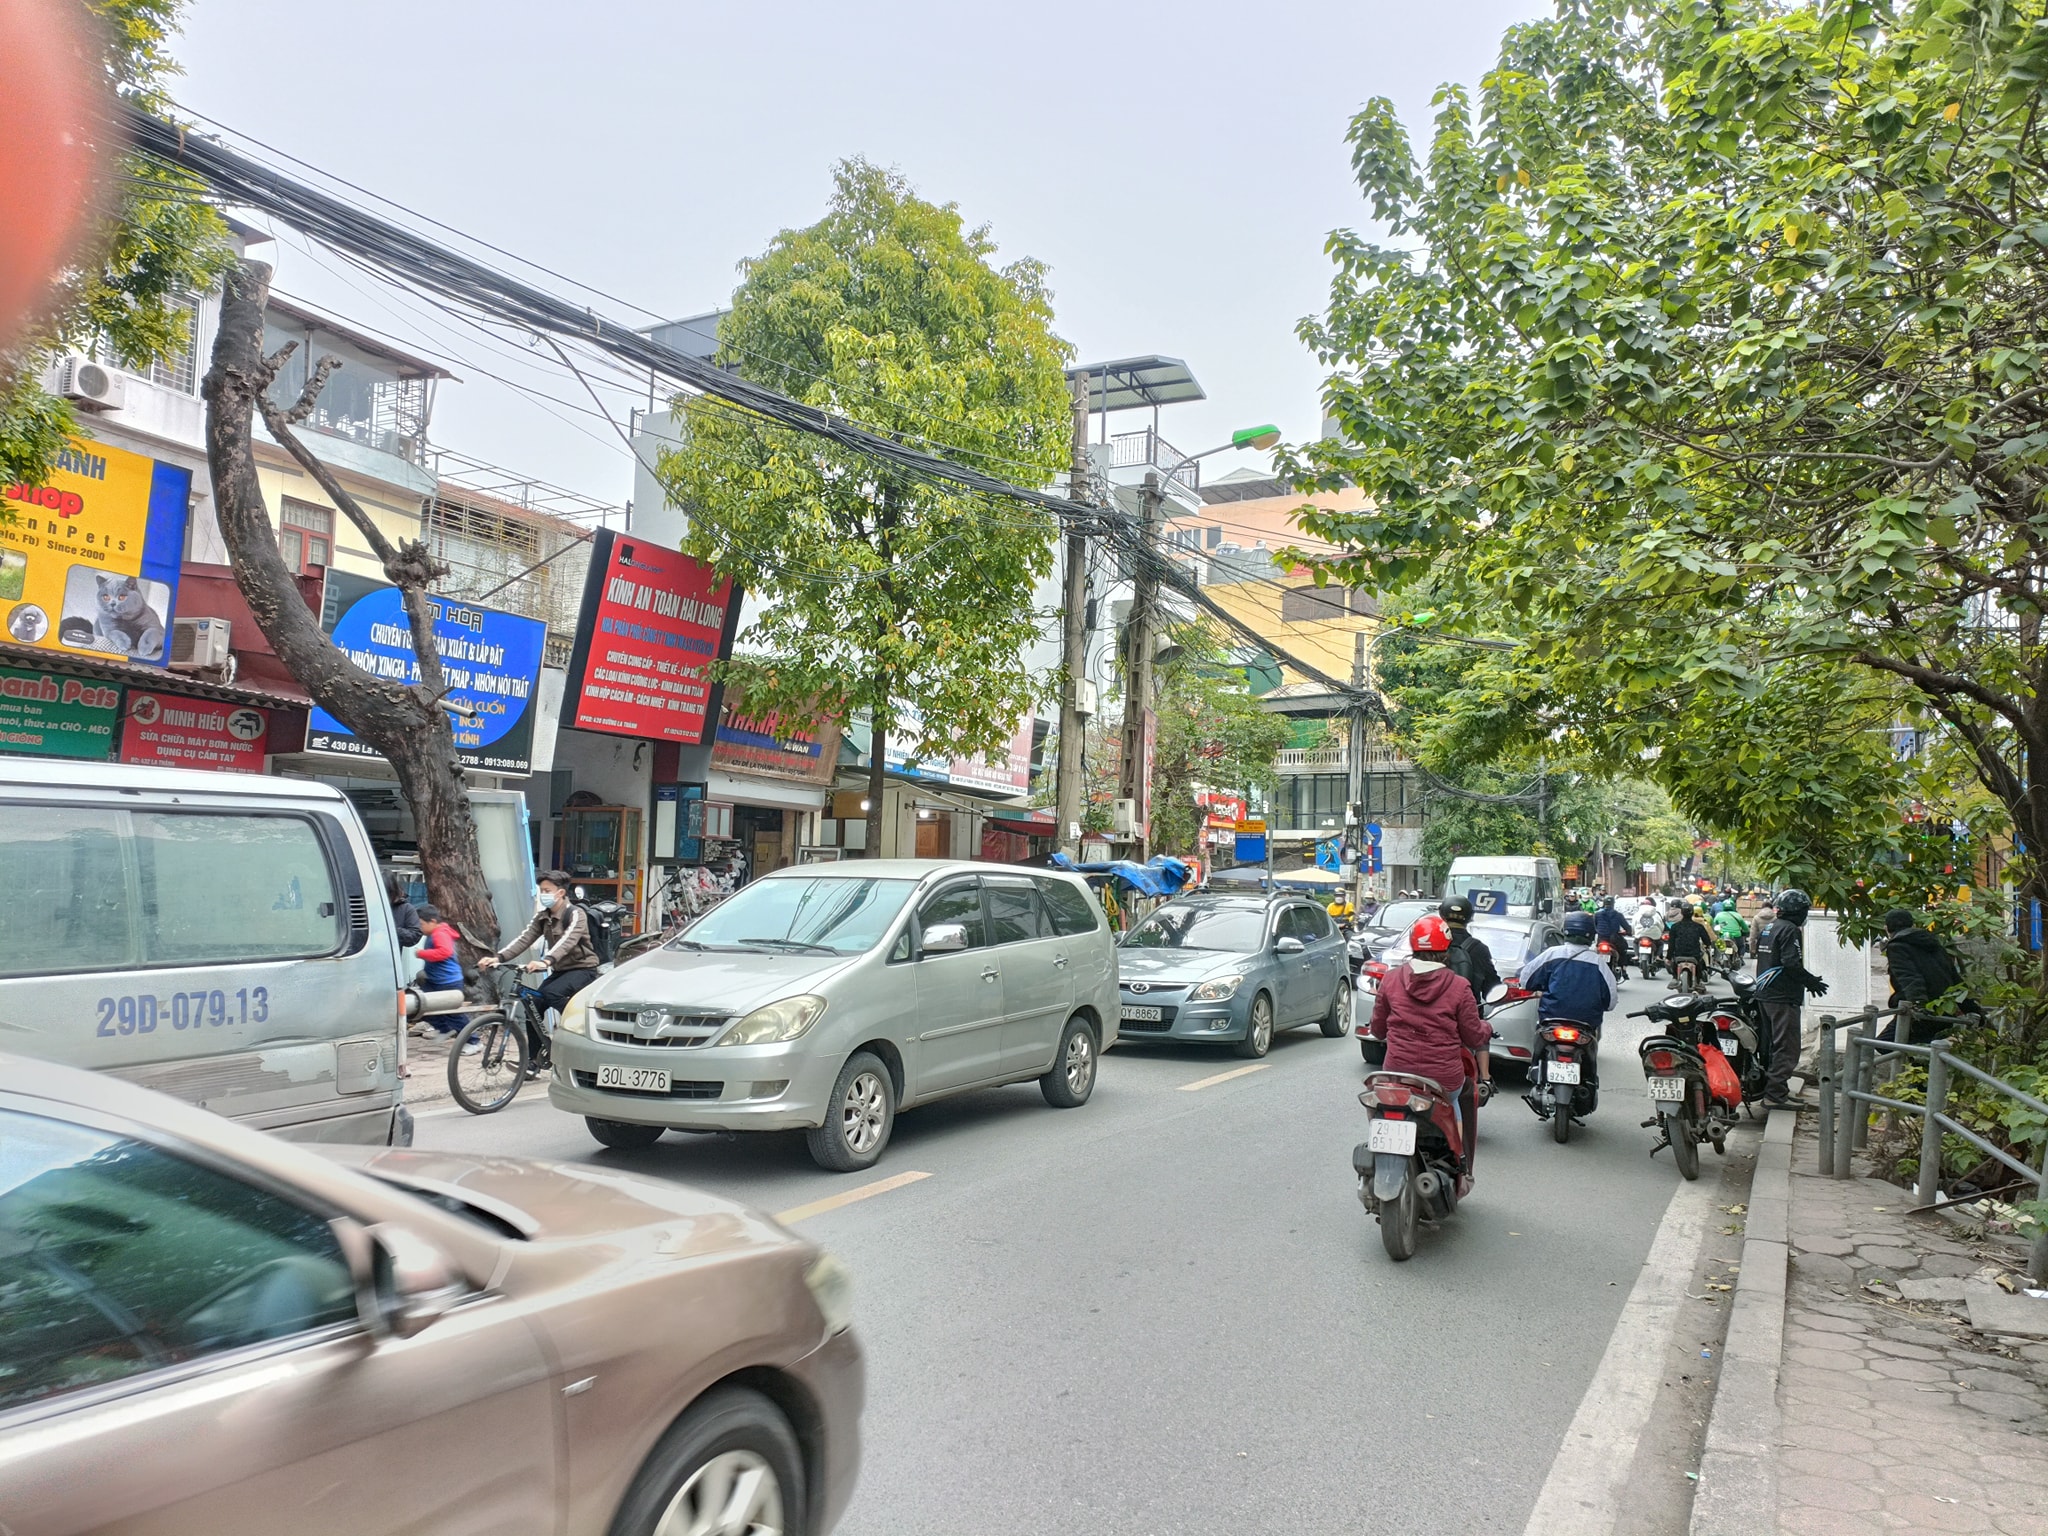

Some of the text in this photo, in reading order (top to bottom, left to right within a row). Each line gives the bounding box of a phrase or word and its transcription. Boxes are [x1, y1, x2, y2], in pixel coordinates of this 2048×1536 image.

[47, 540, 78, 556] Since
[80, 547, 106, 562] 2000
[607, 574, 724, 629] KÍNH AN TOÀN HẢI LONG
[371, 622, 402, 649] CHUYÊN
[447, 635, 469, 660] XUẤT
[468, 643, 476, 661] &
[475, 638, 490, 664] LẮP
[490, 643, 505, 669] ĐẶT
[350, 648, 378, 674] NHÔM
[377, 655, 406, 680] XINGFA
[0, 676, 119, 709] anh Pets
[449, 667, 470, 689] PHÁP
[474, 670, 497, 694] NHÔM
[497, 673, 512, 699] NỘI
[511, 675, 530, 699] THẤT
[476, 699, 506, 715] CUỐN
[163, 709, 225, 731] MINH HIẾU
[140, 730, 159, 742] SỬA
[187, 736, 207, 747] MÁY
[208, 739, 229, 750] BƠM
[230, 741, 254, 753] NƯỚC
[331, 740, 347, 751] 430
[361, 744, 373, 754] La
[460, 730, 480, 746] KÍNH
[157, 746, 181, 758] DỤNG
[184, 749, 196, 760] CỤ
[220, 753, 236, 763] TAY
[1475, 892, 1497, 912] G7
[96, 986, 269, 1038] 29D-079.13
[1650, 1089, 1682, 1100] 515.50
[1651, 1079, 1680, 1089] 29-E1
